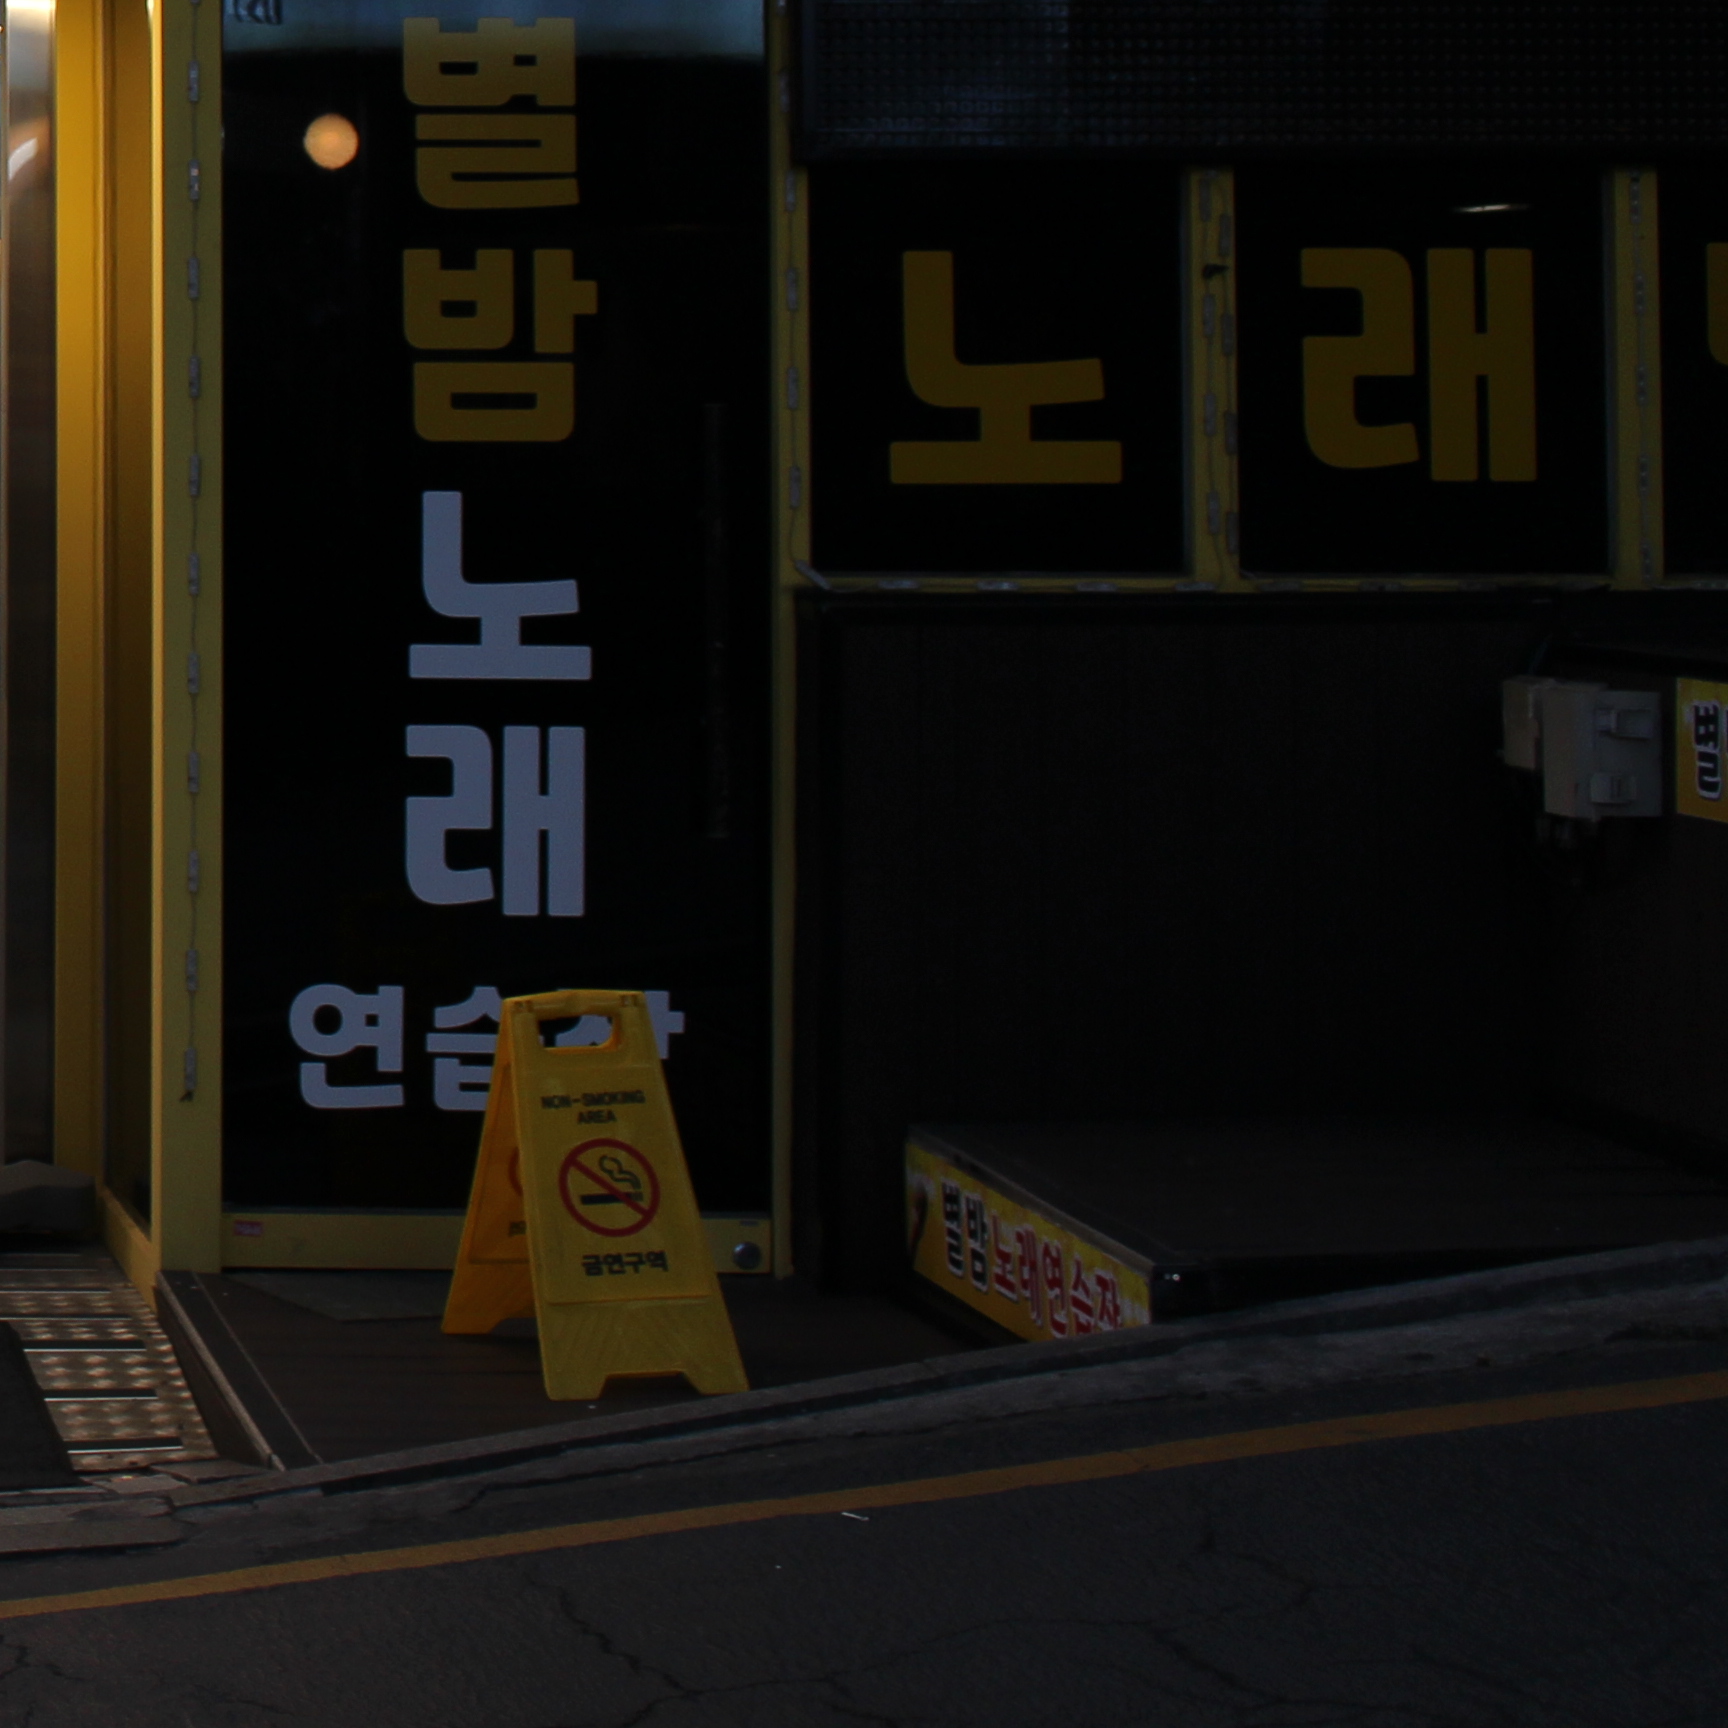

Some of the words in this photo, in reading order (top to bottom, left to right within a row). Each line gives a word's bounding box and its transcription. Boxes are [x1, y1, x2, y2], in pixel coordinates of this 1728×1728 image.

[1692, 700, 1728, 798] 별
[287, 982, 685, 1113] 연습
[577, 1110, 617, 1126] AREA
[581, 1250, 669, 1277] 금연구역
[940, 1180, 990, 1294] 별밤
